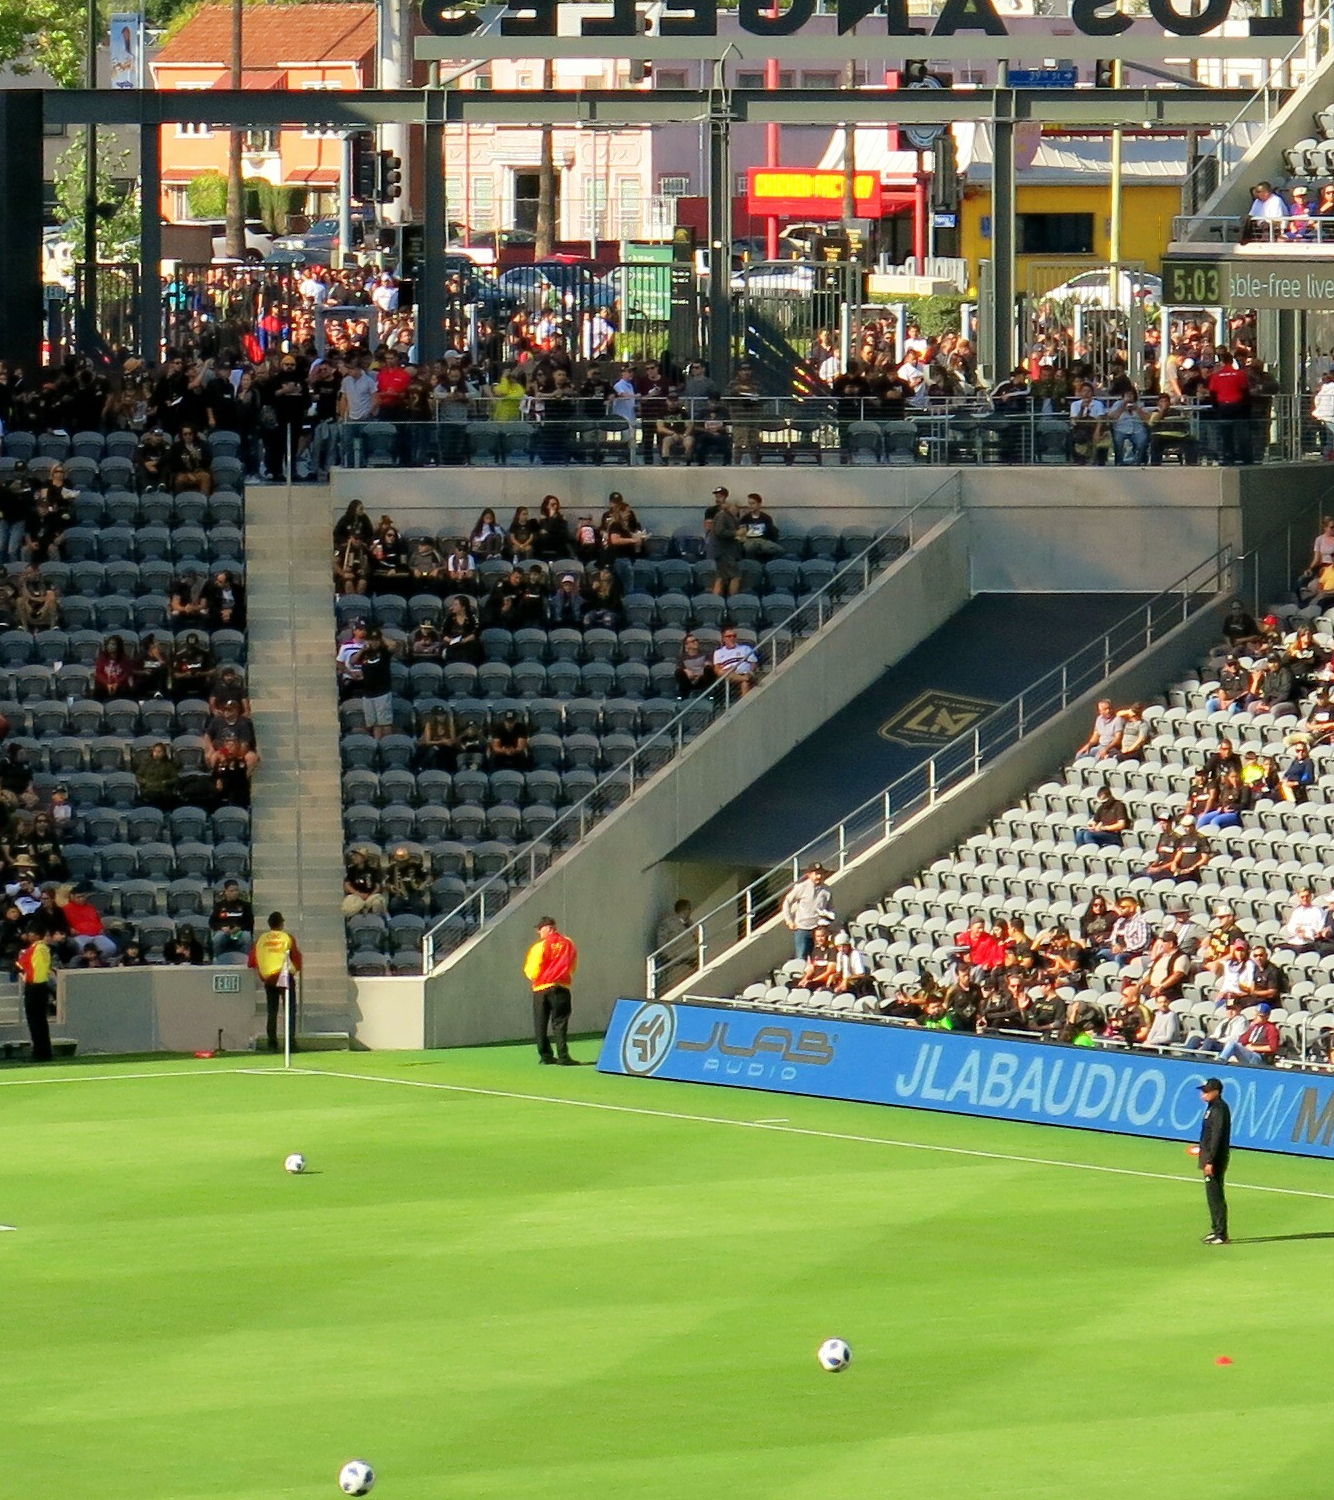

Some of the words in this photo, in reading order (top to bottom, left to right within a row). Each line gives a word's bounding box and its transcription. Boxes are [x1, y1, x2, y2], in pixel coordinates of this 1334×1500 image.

[1174, 268, 1218, 301] 5:03
[1307, 273, 1334, 299] live
[674, 1021, 835, 1066] JLAB
[703, 1058, 797, 1080] AUDIO
